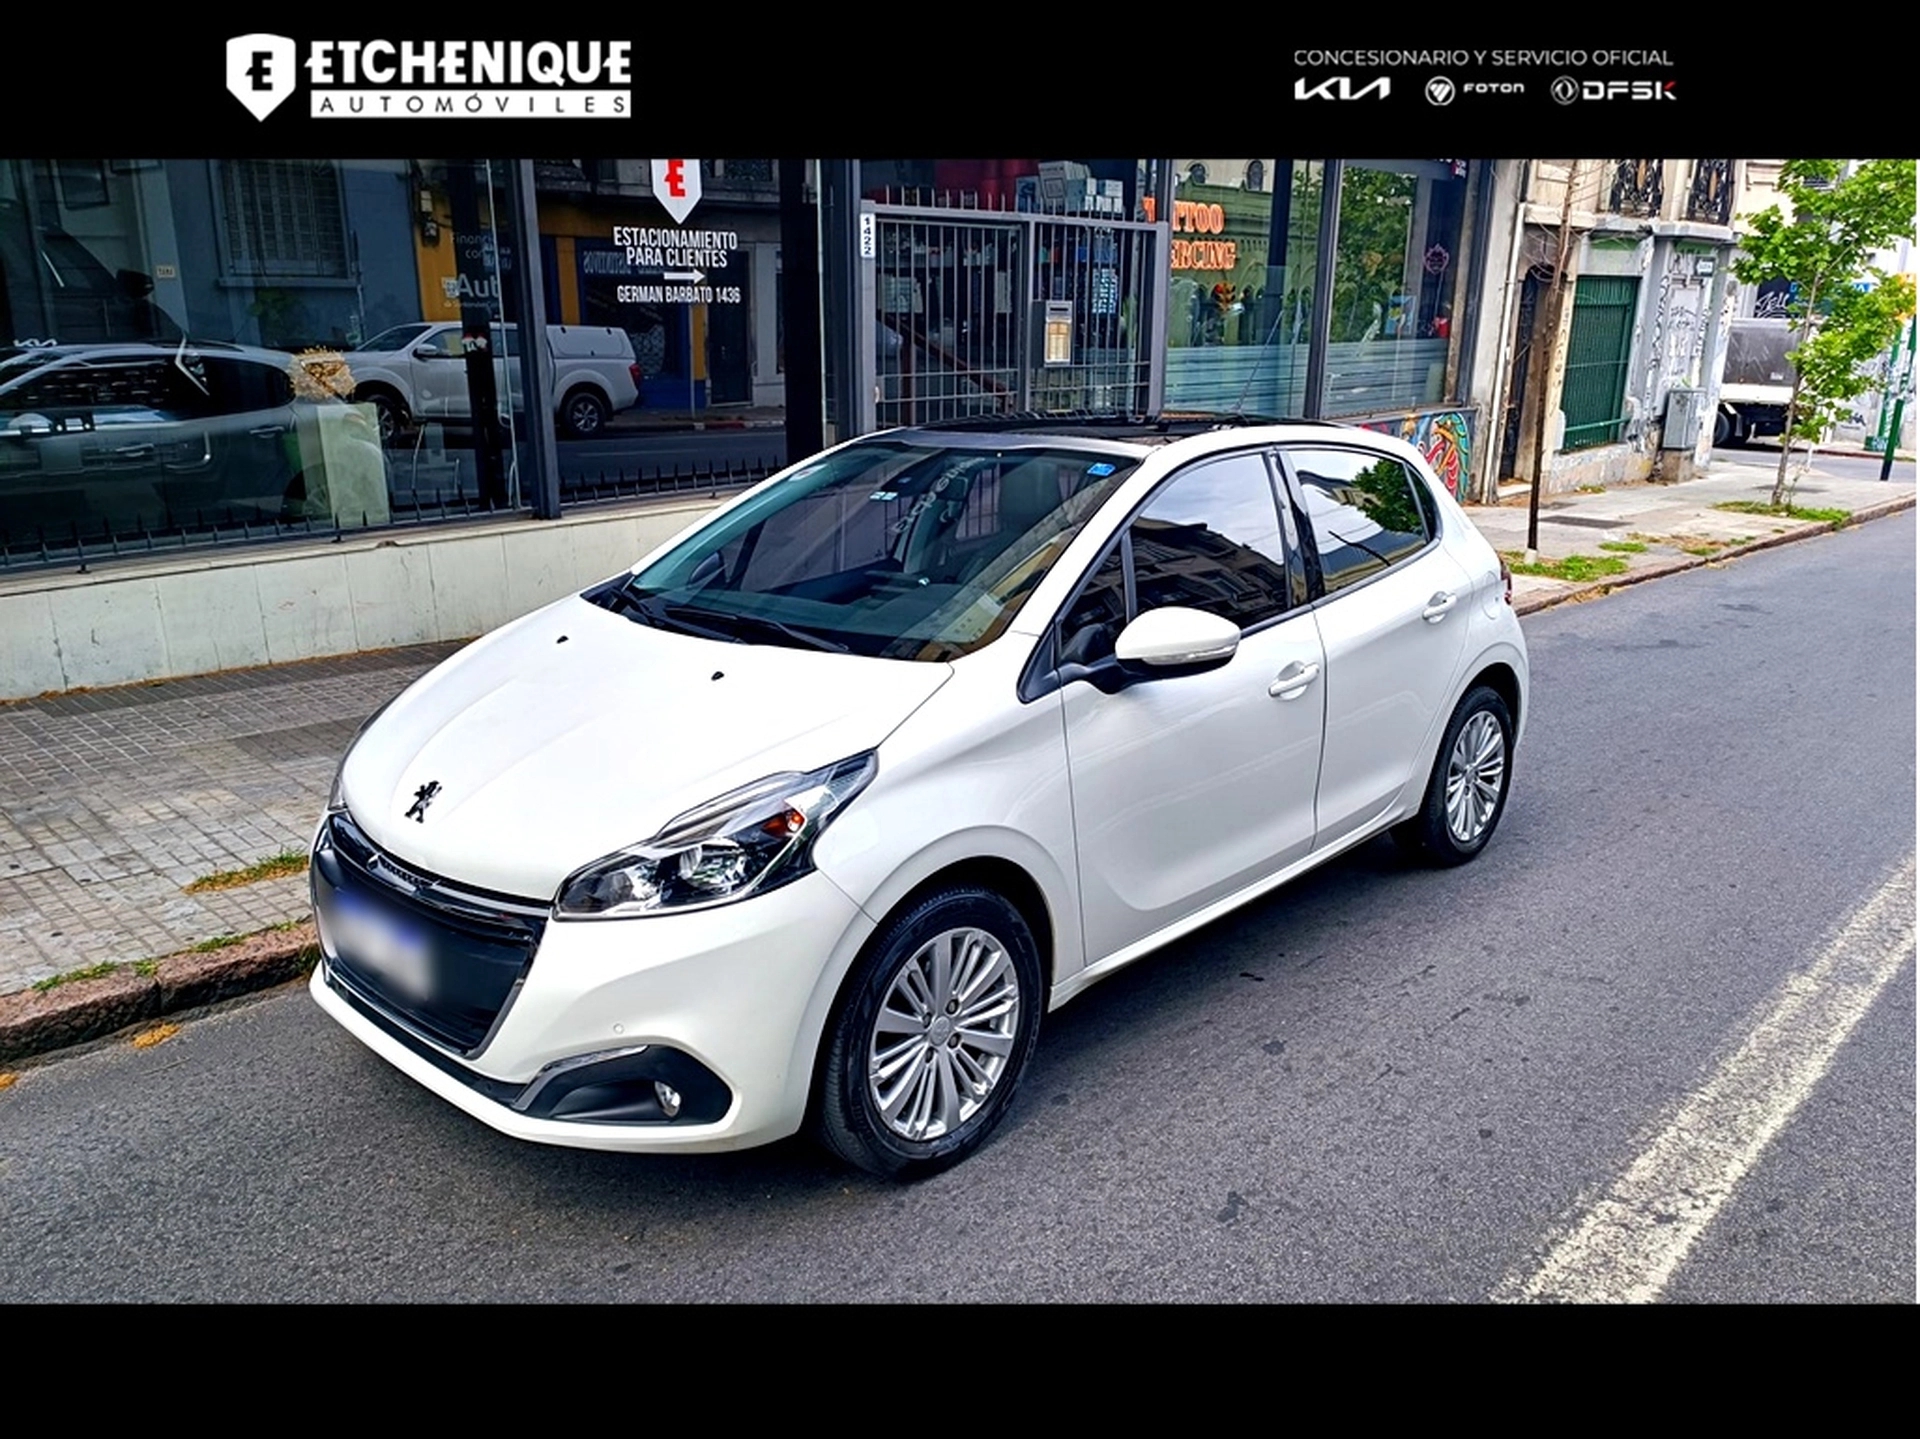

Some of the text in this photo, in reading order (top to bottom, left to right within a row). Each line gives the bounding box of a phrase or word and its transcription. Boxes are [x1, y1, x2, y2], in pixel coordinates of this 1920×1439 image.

[664, 159, 686, 197] E
[613, 226, 738, 250] ESTACIONAMIENTO
[863, 216, 871, 255] 1422
[626, 247, 663, 266] PARA
[666, 248, 728, 268] CLIENTES
[457, 273, 500, 298] Aut
[617, 285, 741, 303] GERMAN BARBATO 1436
